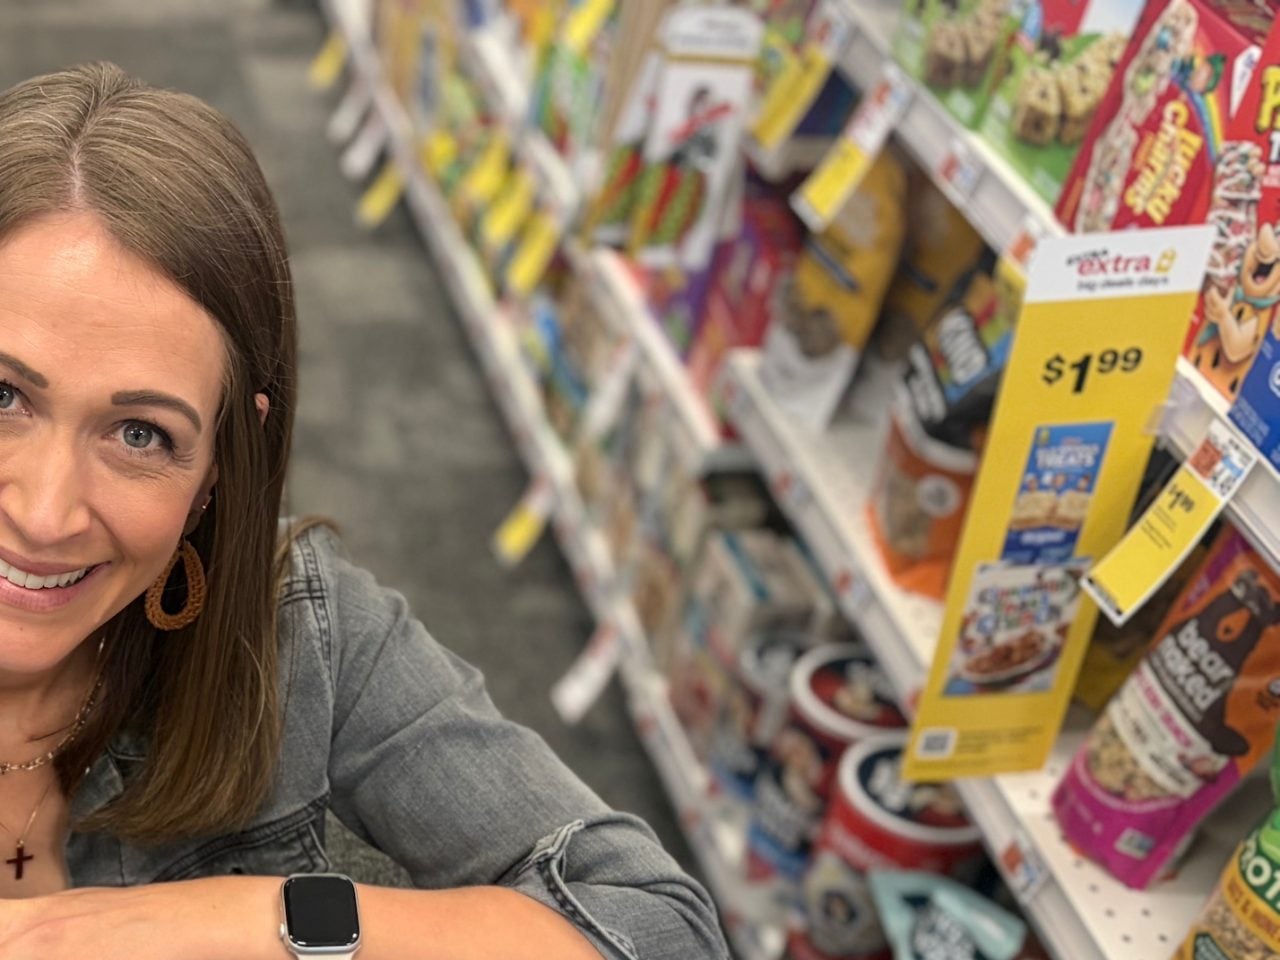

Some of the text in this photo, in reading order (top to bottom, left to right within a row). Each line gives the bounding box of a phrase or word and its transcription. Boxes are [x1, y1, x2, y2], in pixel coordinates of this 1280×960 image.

[1077, 255, 1151, 276] extra
[1157, 633, 1221, 711] naked
[1176, 618, 1235, 684] bear
